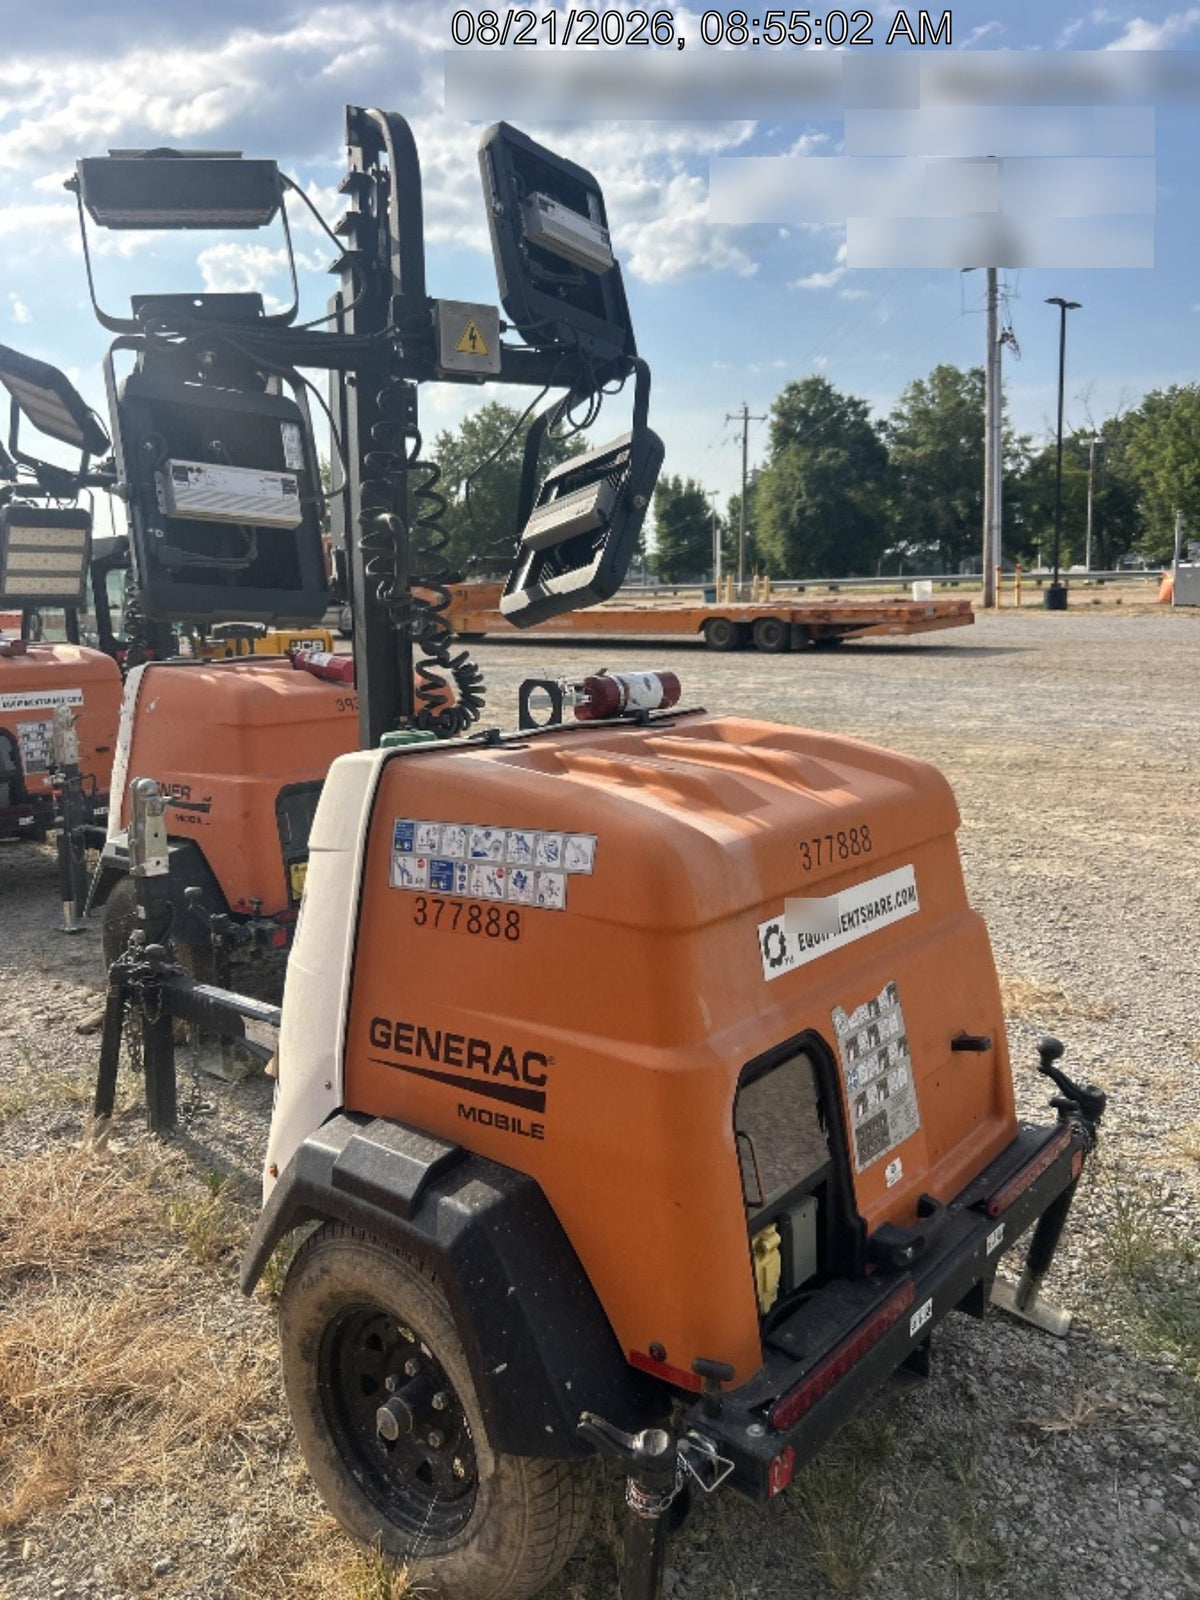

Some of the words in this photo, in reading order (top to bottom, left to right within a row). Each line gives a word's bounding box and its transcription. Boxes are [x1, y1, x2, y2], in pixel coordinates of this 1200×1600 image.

[800, 825, 872, 871] 377888
[413, 896, 521, 942] 377888
[457, 1103, 545, 1141] MOBILE
